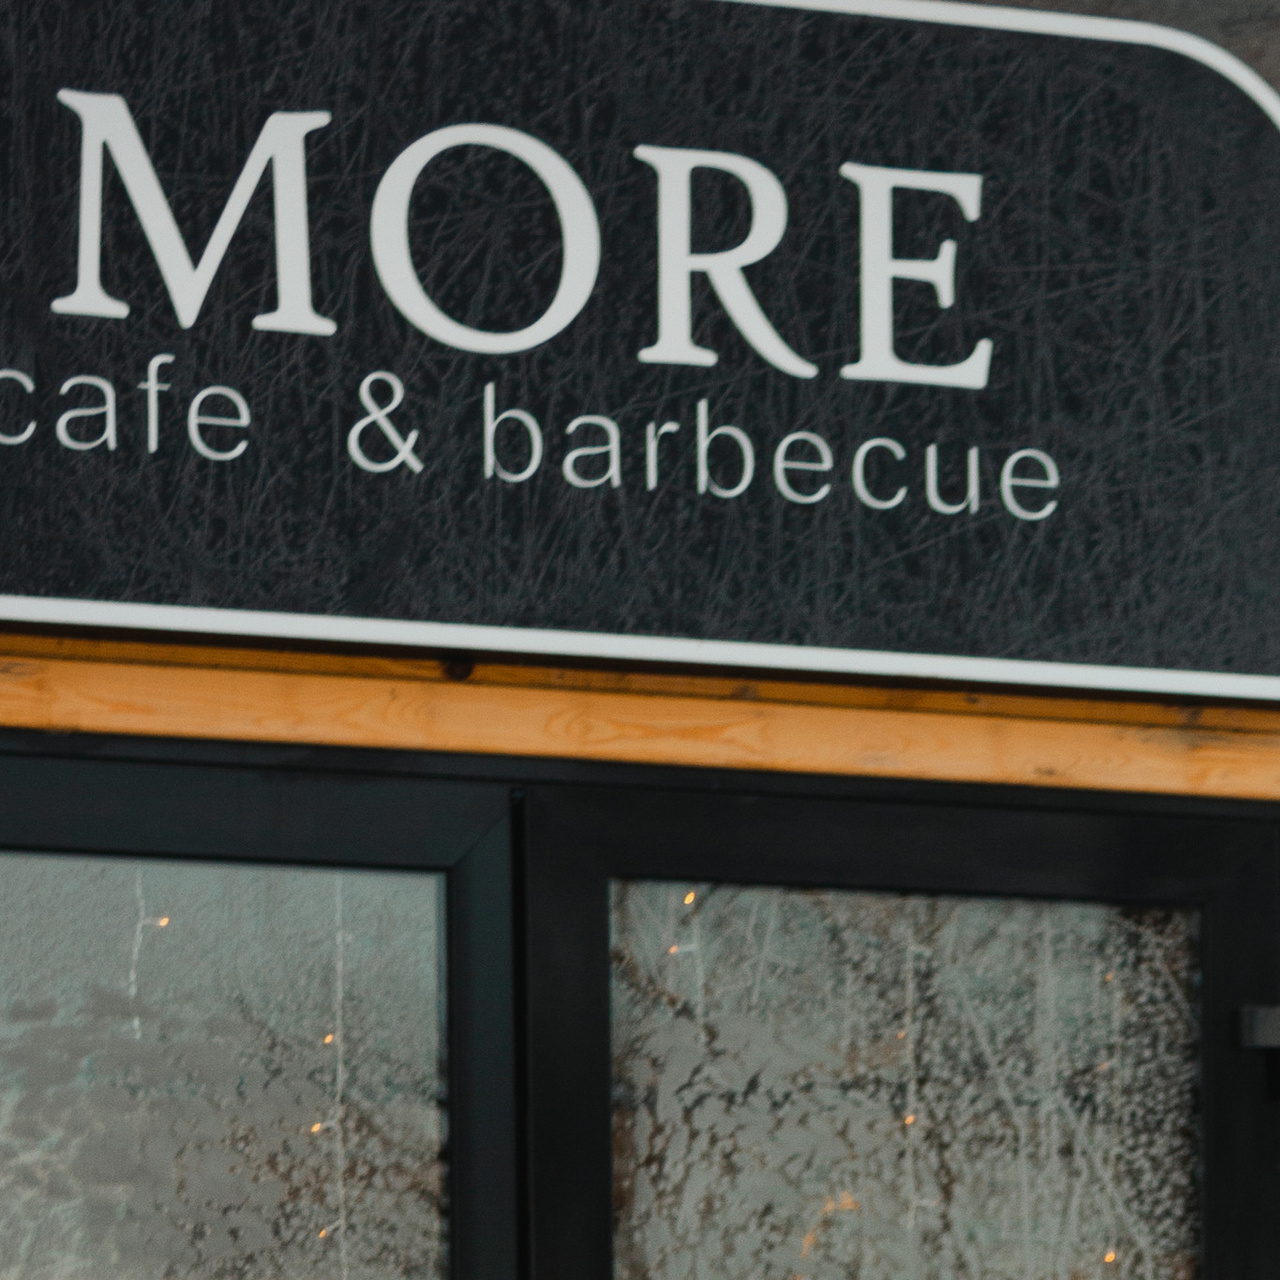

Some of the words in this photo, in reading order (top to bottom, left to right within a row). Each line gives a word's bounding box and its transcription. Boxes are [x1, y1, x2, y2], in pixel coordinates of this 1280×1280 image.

[50, 87, 994, 390] MORE
[0, 353, 251, 461] cafe
[347, 370, 425, 474] &
[483, 381, 1061, 521] barbecue
